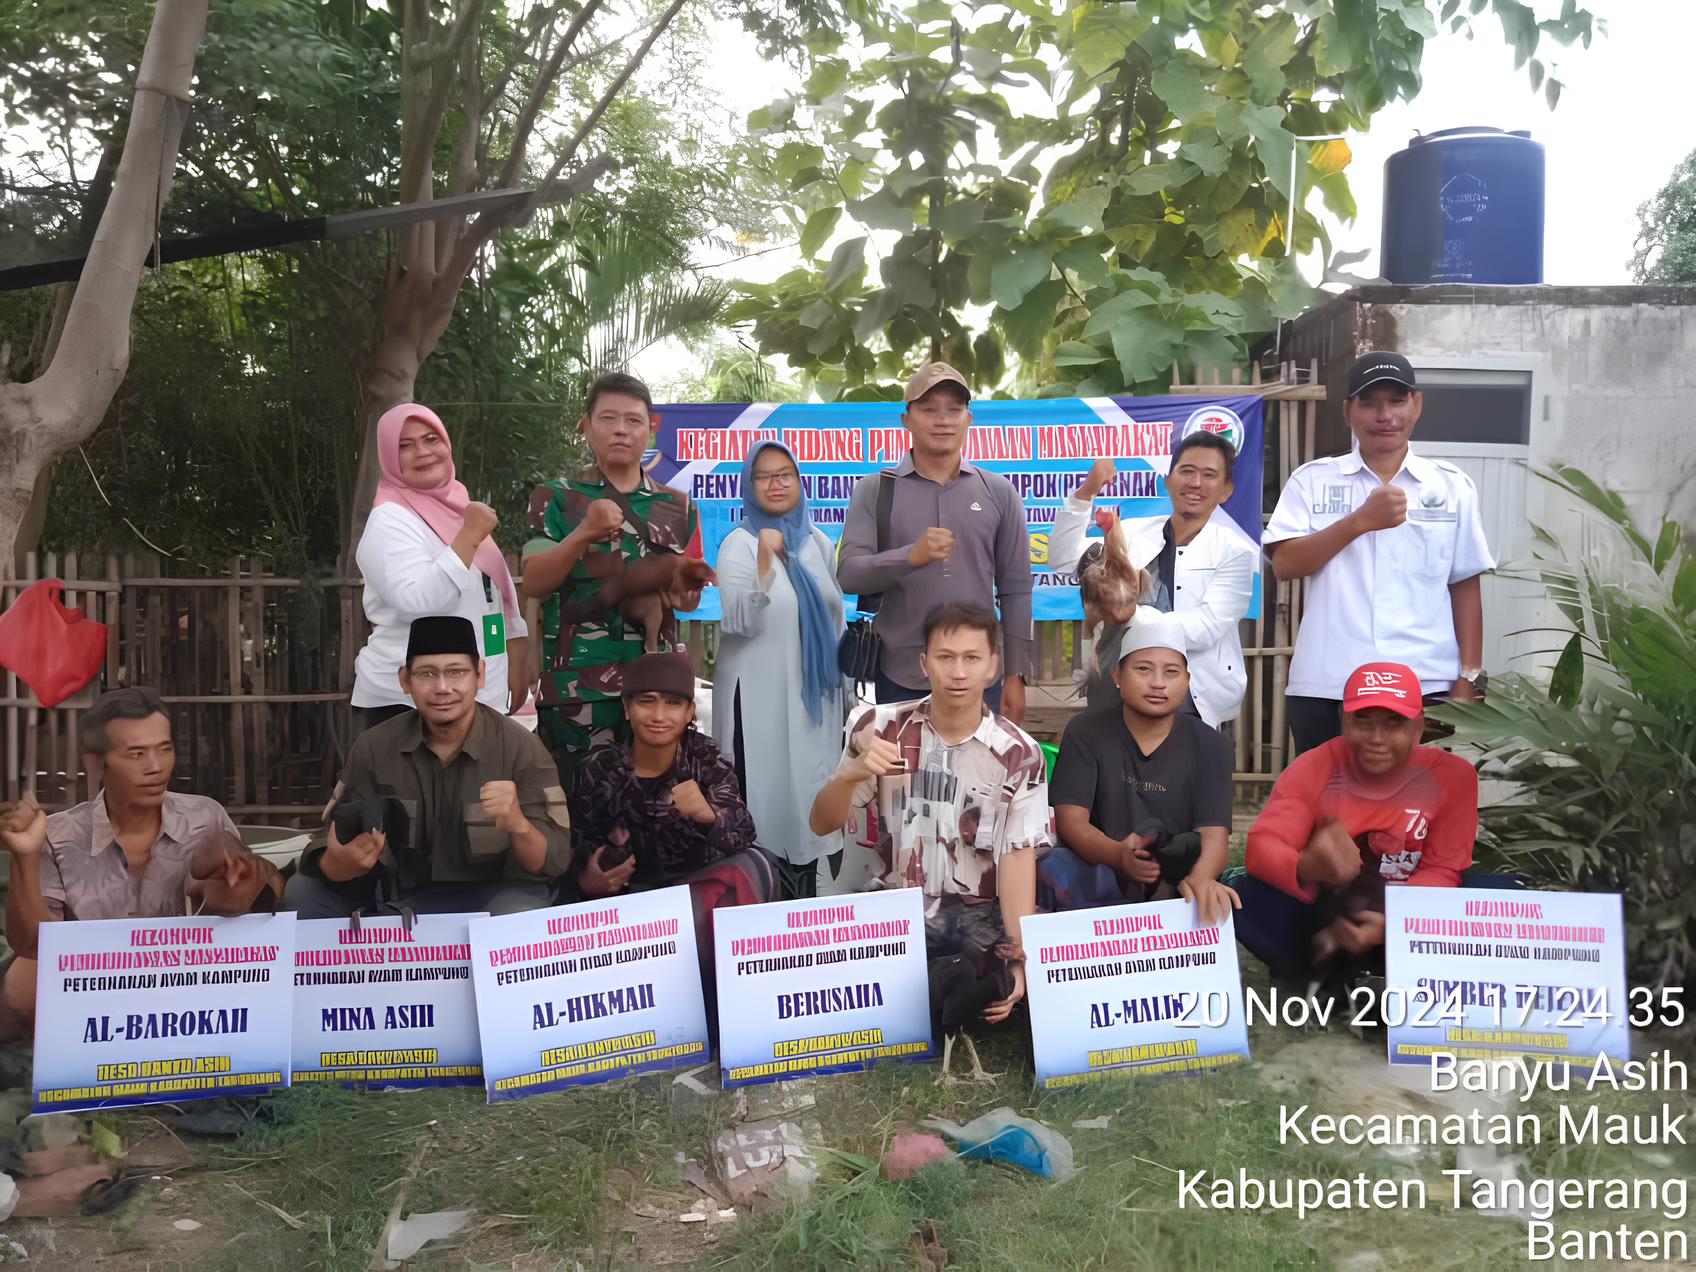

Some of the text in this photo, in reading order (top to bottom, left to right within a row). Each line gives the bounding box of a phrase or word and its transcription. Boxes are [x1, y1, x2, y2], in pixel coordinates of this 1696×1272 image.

[321, 1006, 376, 1032] MINA
[532, 983, 656, 1031] AL-HIKMAH
[777, 982, 883, 1020] BERUSAHA
